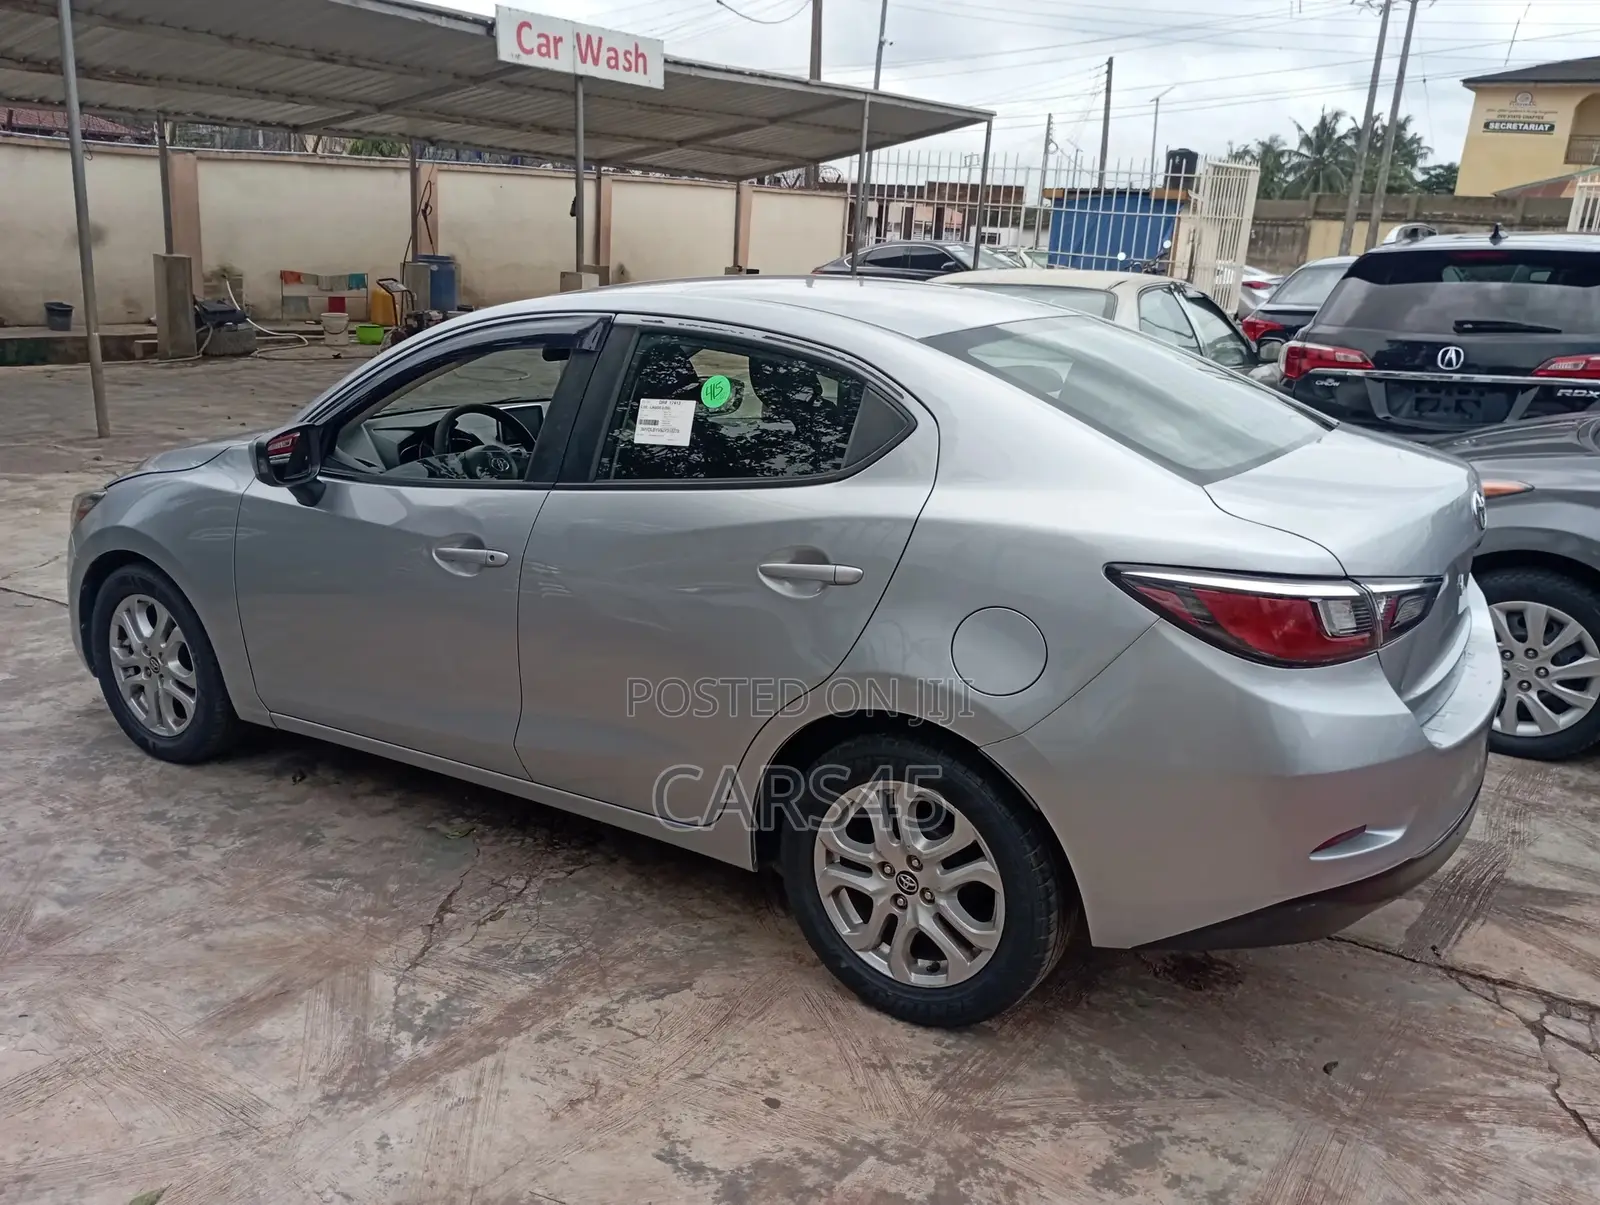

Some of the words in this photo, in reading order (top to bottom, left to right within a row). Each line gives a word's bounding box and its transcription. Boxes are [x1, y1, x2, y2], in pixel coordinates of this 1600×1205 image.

[516, 21, 563, 60] Car
[575, 32, 648, 75] Wash
[1488, 122, 1551, 131] SECRETARIAT
[705, 381, 723, 401] 415
[1557, 389, 1600, 399] RDX
